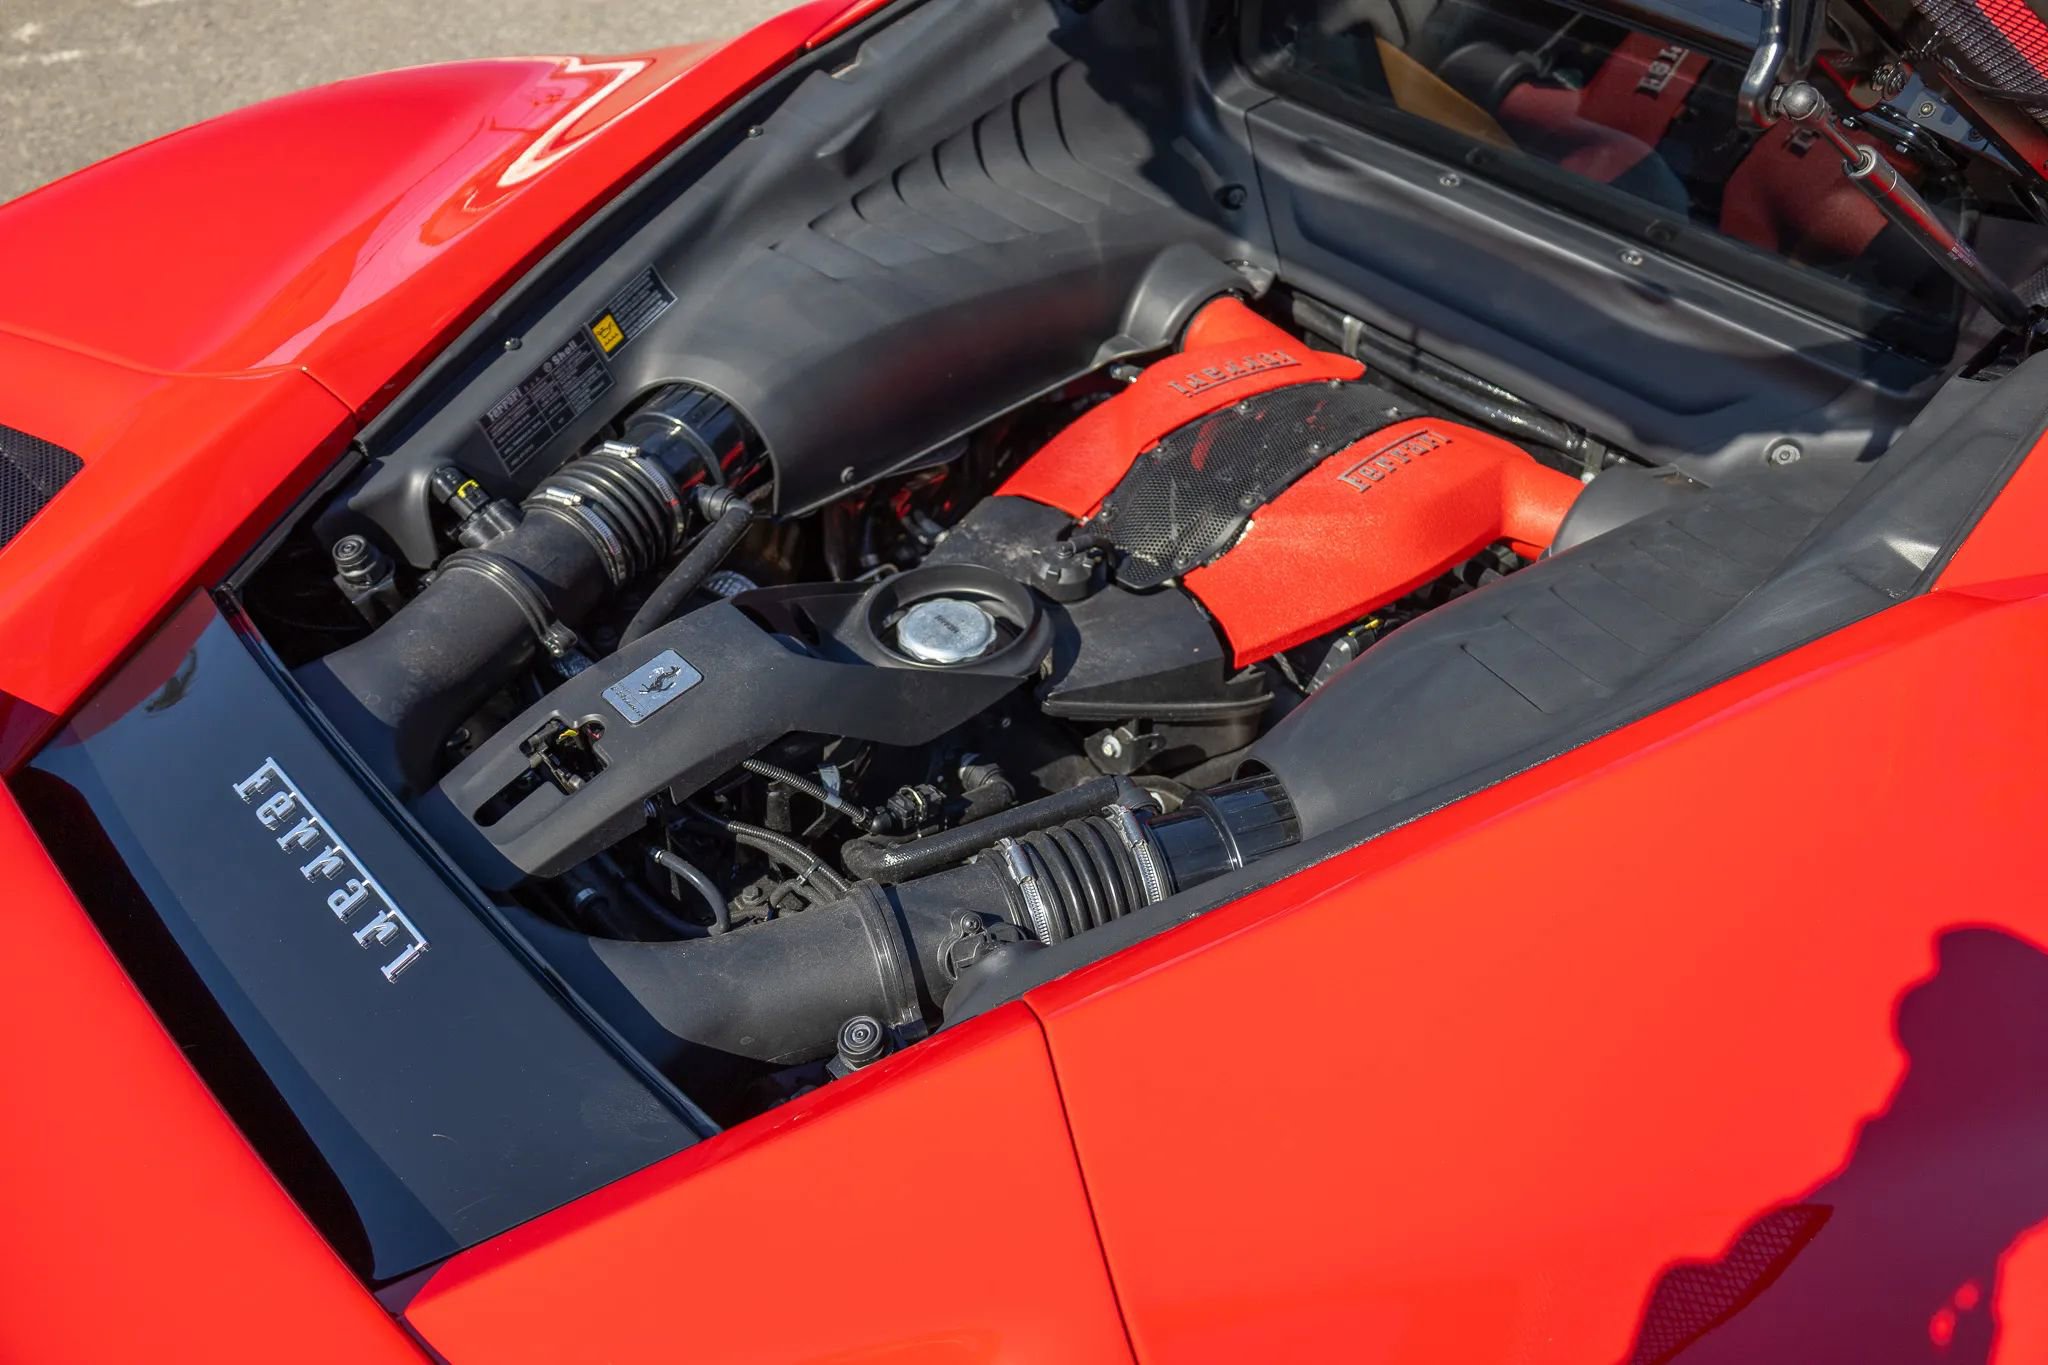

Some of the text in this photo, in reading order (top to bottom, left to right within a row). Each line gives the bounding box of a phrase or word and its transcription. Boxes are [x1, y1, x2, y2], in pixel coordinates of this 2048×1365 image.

[551, 339, 578, 365] Shell
[1168, 349, 1302, 398] Ferrari
[486, 386, 523, 421] Ferrari
[1337, 427, 1453, 493] Ferrari
[233, 756, 431, 983] Ferrari
